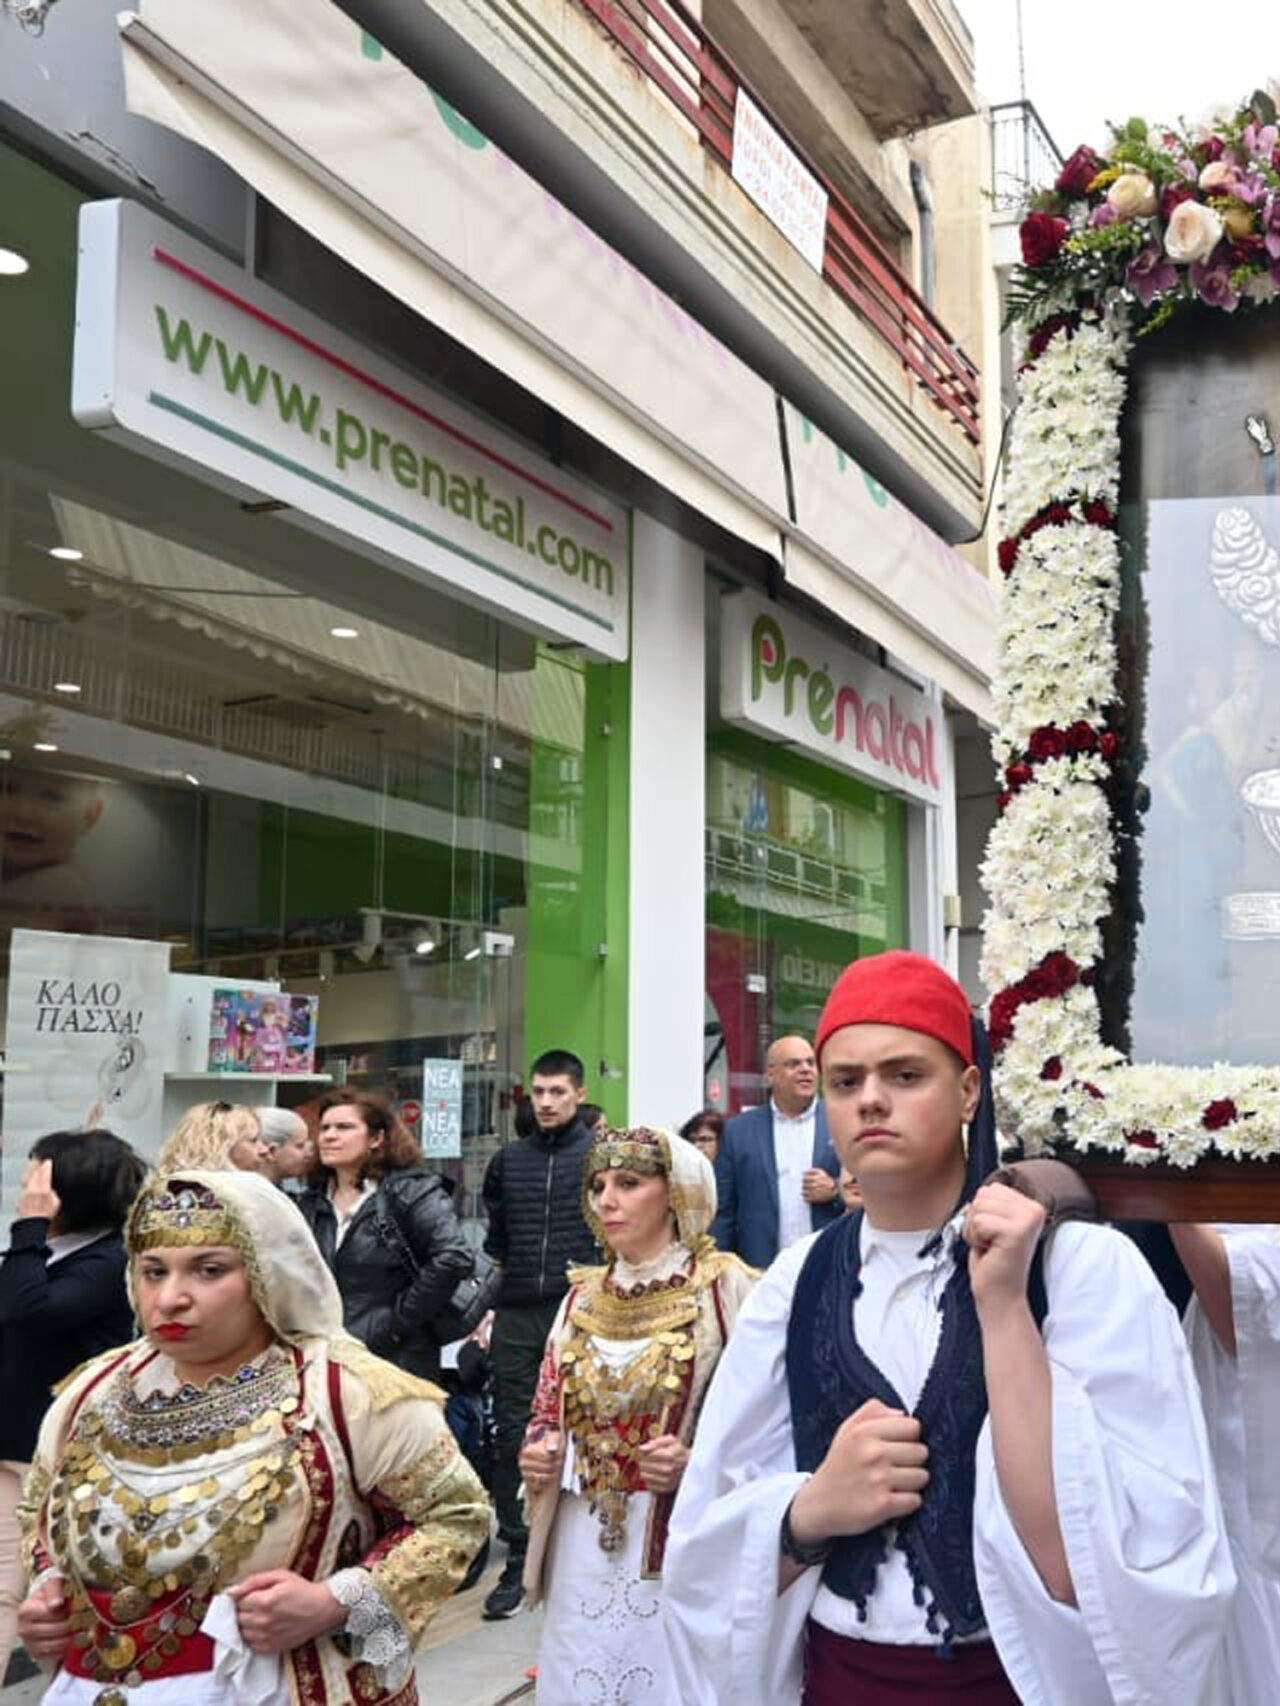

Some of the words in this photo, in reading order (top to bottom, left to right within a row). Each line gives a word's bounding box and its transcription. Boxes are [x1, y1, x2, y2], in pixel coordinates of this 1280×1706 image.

[154, 304, 615, 597] www.prenatal.com
[36, 980, 121, 1006] ΚΑΛΟ
[36, 1007, 143, 1035] ΠΑΣΧΑ!
